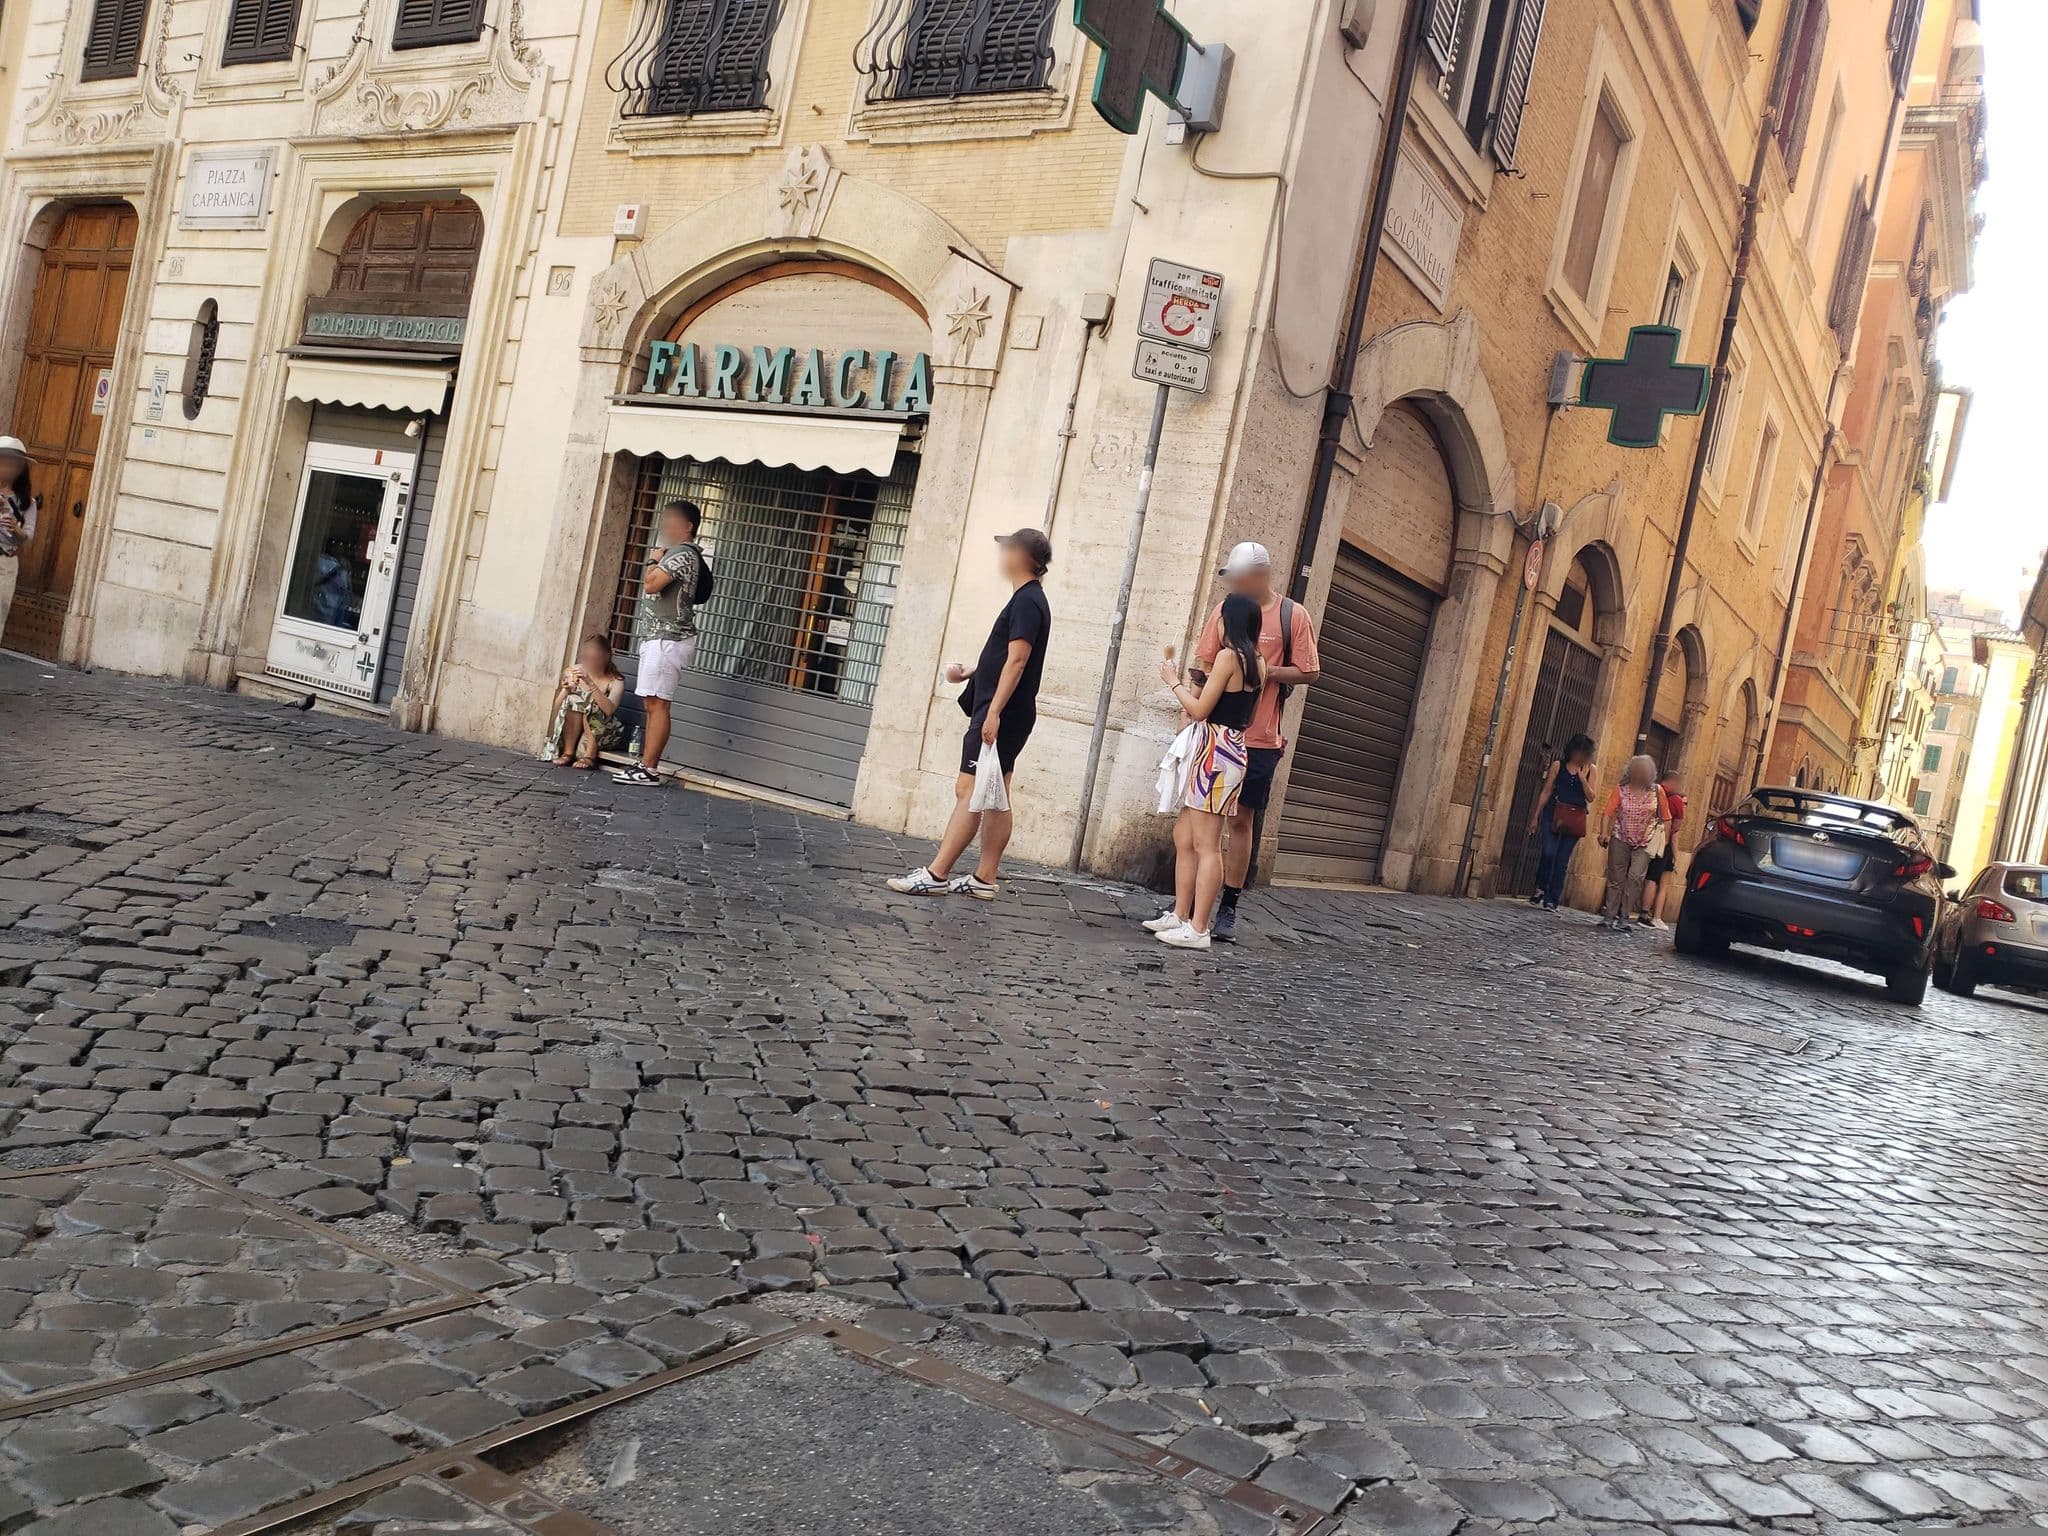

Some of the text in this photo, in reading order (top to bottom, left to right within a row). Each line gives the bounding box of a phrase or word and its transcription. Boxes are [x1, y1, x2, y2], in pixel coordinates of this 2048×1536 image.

[207, 169, 246, 184] PIAZZA
[192, 191, 255, 207] CAPRANICA
[1420, 183, 1436, 219] VIA
[1411, 208, 1433, 241] DELLE
[1386, 207, 1447, 288] COLONNELLE
[553, 272, 572, 291] 96
[1151, 277, 1183, 293] traffico
[383, 319, 461, 341] FARMACIA
[1161, 350, 1188, 361] eccetto
[641, 340, 932, 413] FARMACIA
[1144, 366, 1157, 376] taxi
[1163, 372, 1196, 385] autorizzati
